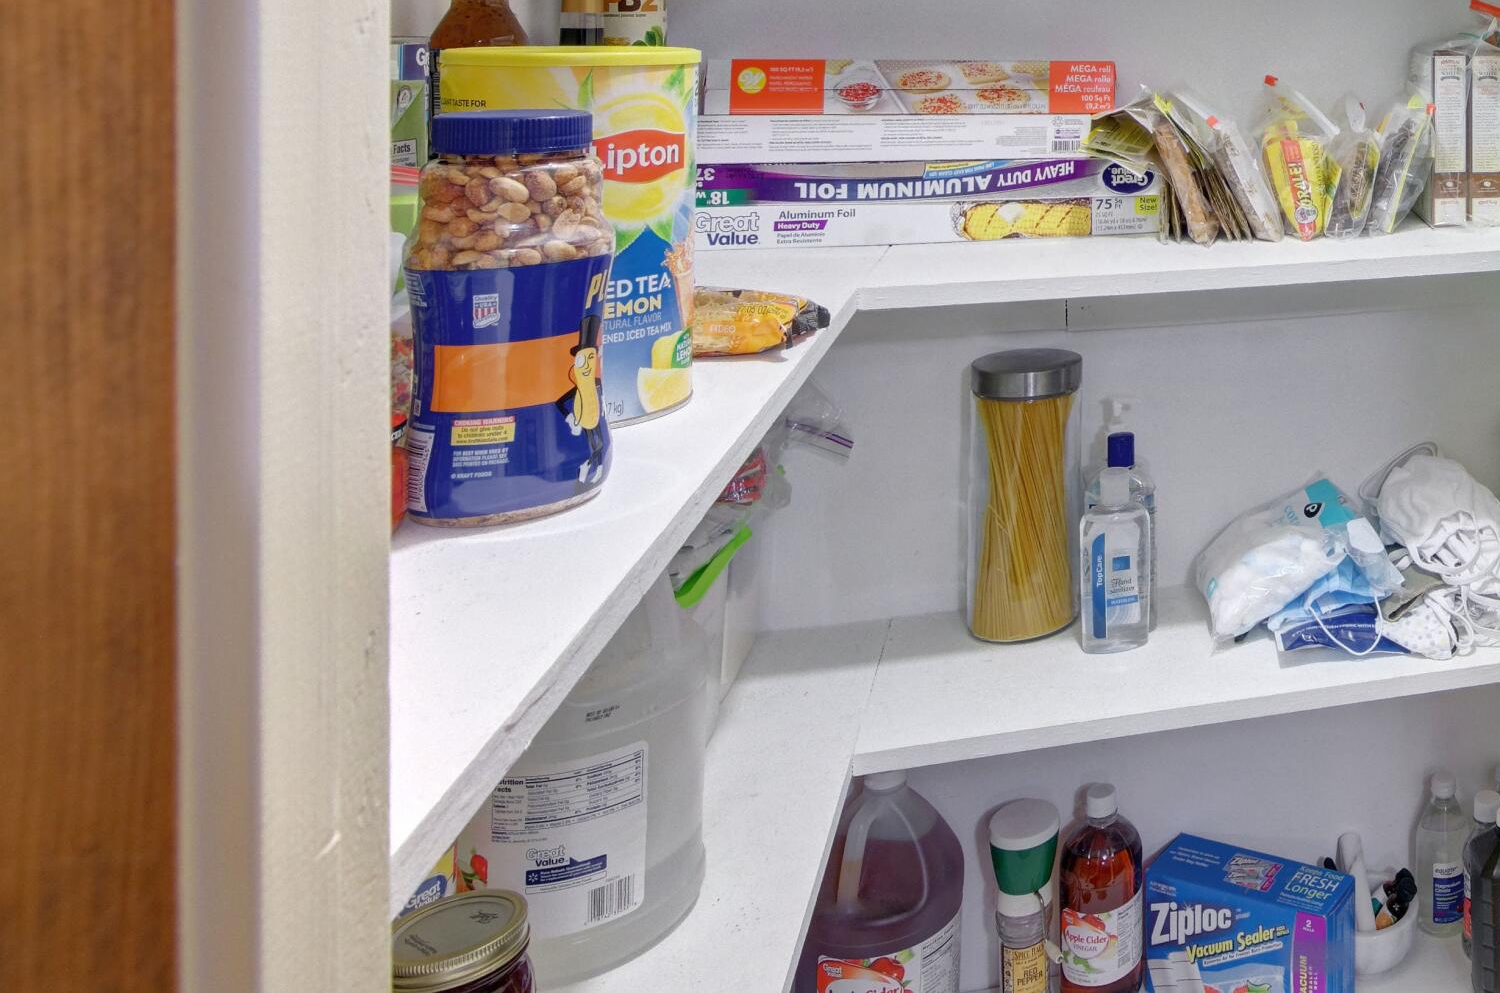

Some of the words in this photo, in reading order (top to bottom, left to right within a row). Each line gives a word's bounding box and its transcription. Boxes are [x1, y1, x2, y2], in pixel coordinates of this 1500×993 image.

[1071, 65, 1097, 73] MEGA
[1099, 65, 1111, 73] roll
[1066, 75, 1093, 83] MEGA
[1094, 74, 1111, 83] rollo
[471, 99, 487, 108] FOR
[1094, 95, 1103, 103] Sq
[393, 143, 411, 155] Facts
[997, 170, 1032, 187] DUTY
[1033, 160, 1075, 182] HEAVY
[794, 183, 848, 200] FOIL
[857, 177, 991, 199] ALUMINUM
[1095, 198, 1113, 211] 75
[695, 211, 760, 233] Great
[779, 210, 835, 220] Aluminum
[837, 208, 856, 218] Foil
[777, 222, 801, 231] Heavy
[801, 221, 821, 231] Duty
[707, 231, 759, 246] Value
[635, 272, 672, 295] TEA
[604, 294, 662, 320] EMON
[604, 318, 633, 331] TURAL
[633, 311, 662, 326] FLAVOR
[626, 329, 645, 341] ICED
[646, 325, 660, 339] TEA
[660, 321, 673, 336] MIX
[1111, 577, 1132, 588] Hand
[526, 845, 566, 861] Great
[535, 857, 565, 868] Value
[1291, 872, 1339, 892] FRESH
[1301, 866, 1325, 878] Keeps
[1326, 871, 1345, 882] Food
[405, 880, 441, 909] Great
[1284, 884, 1332, 901] Longer
[1150, 901, 1232, 946] Ziploc
[1305, 919, 1312, 928] 2
[1065, 930, 1085, 944] Apple
[1085, 935, 1108, 944] Cider
[1186, 937, 1234, 964] Vacuum
[1236, 924, 1276, 951] Sealer
[1016, 970, 1043, 987] PEPPER
[1023, 967, 1038, 978] RED
[1299, 955, 1308, 993] ACUUM
